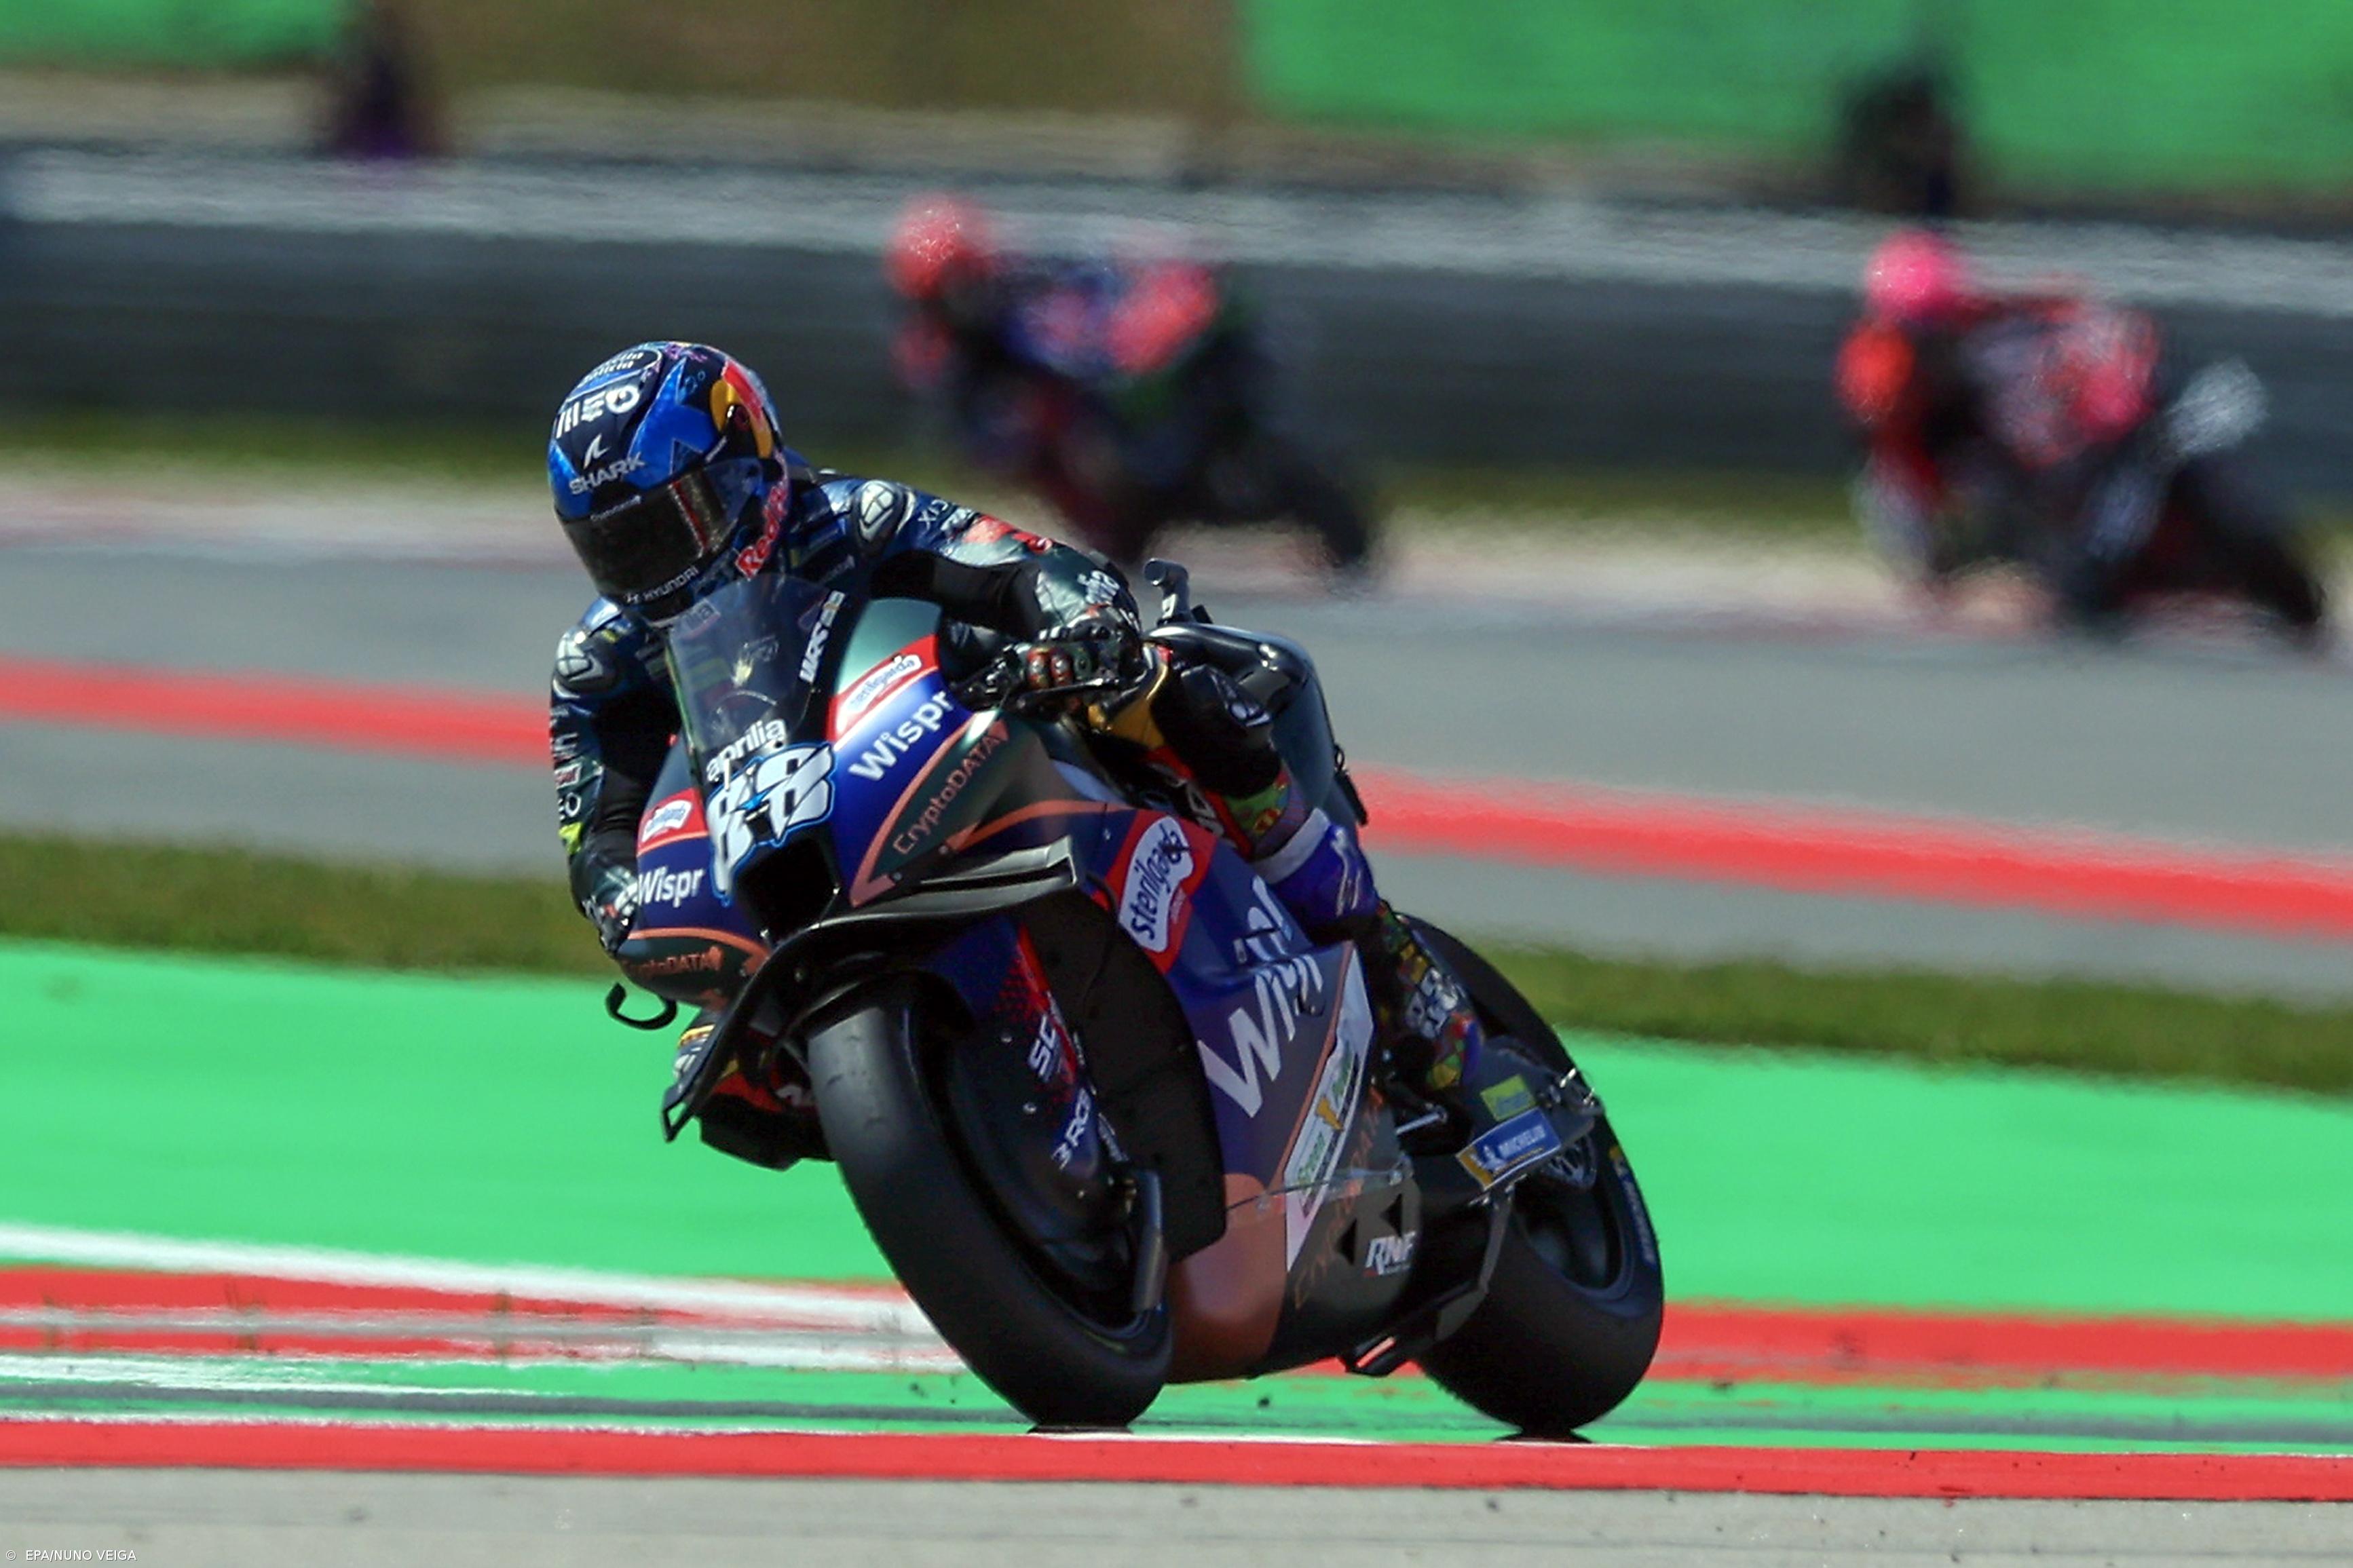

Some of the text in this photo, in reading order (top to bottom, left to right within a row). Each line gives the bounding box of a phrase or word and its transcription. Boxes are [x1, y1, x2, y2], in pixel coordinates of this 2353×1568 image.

[569, 452, 645, 495] SHARK
[643, 565, 700, 600] HYUNDAI
[799, 621, 829, 683] WRS
[707, 719, 786, 792] aprilia
[848, 691, 953, 781] Wispr
[708, 746, 833, 893] 88
[893, 733, 1001, 854] CryptoDATA
[638, 866, 704, 908] Wispr
